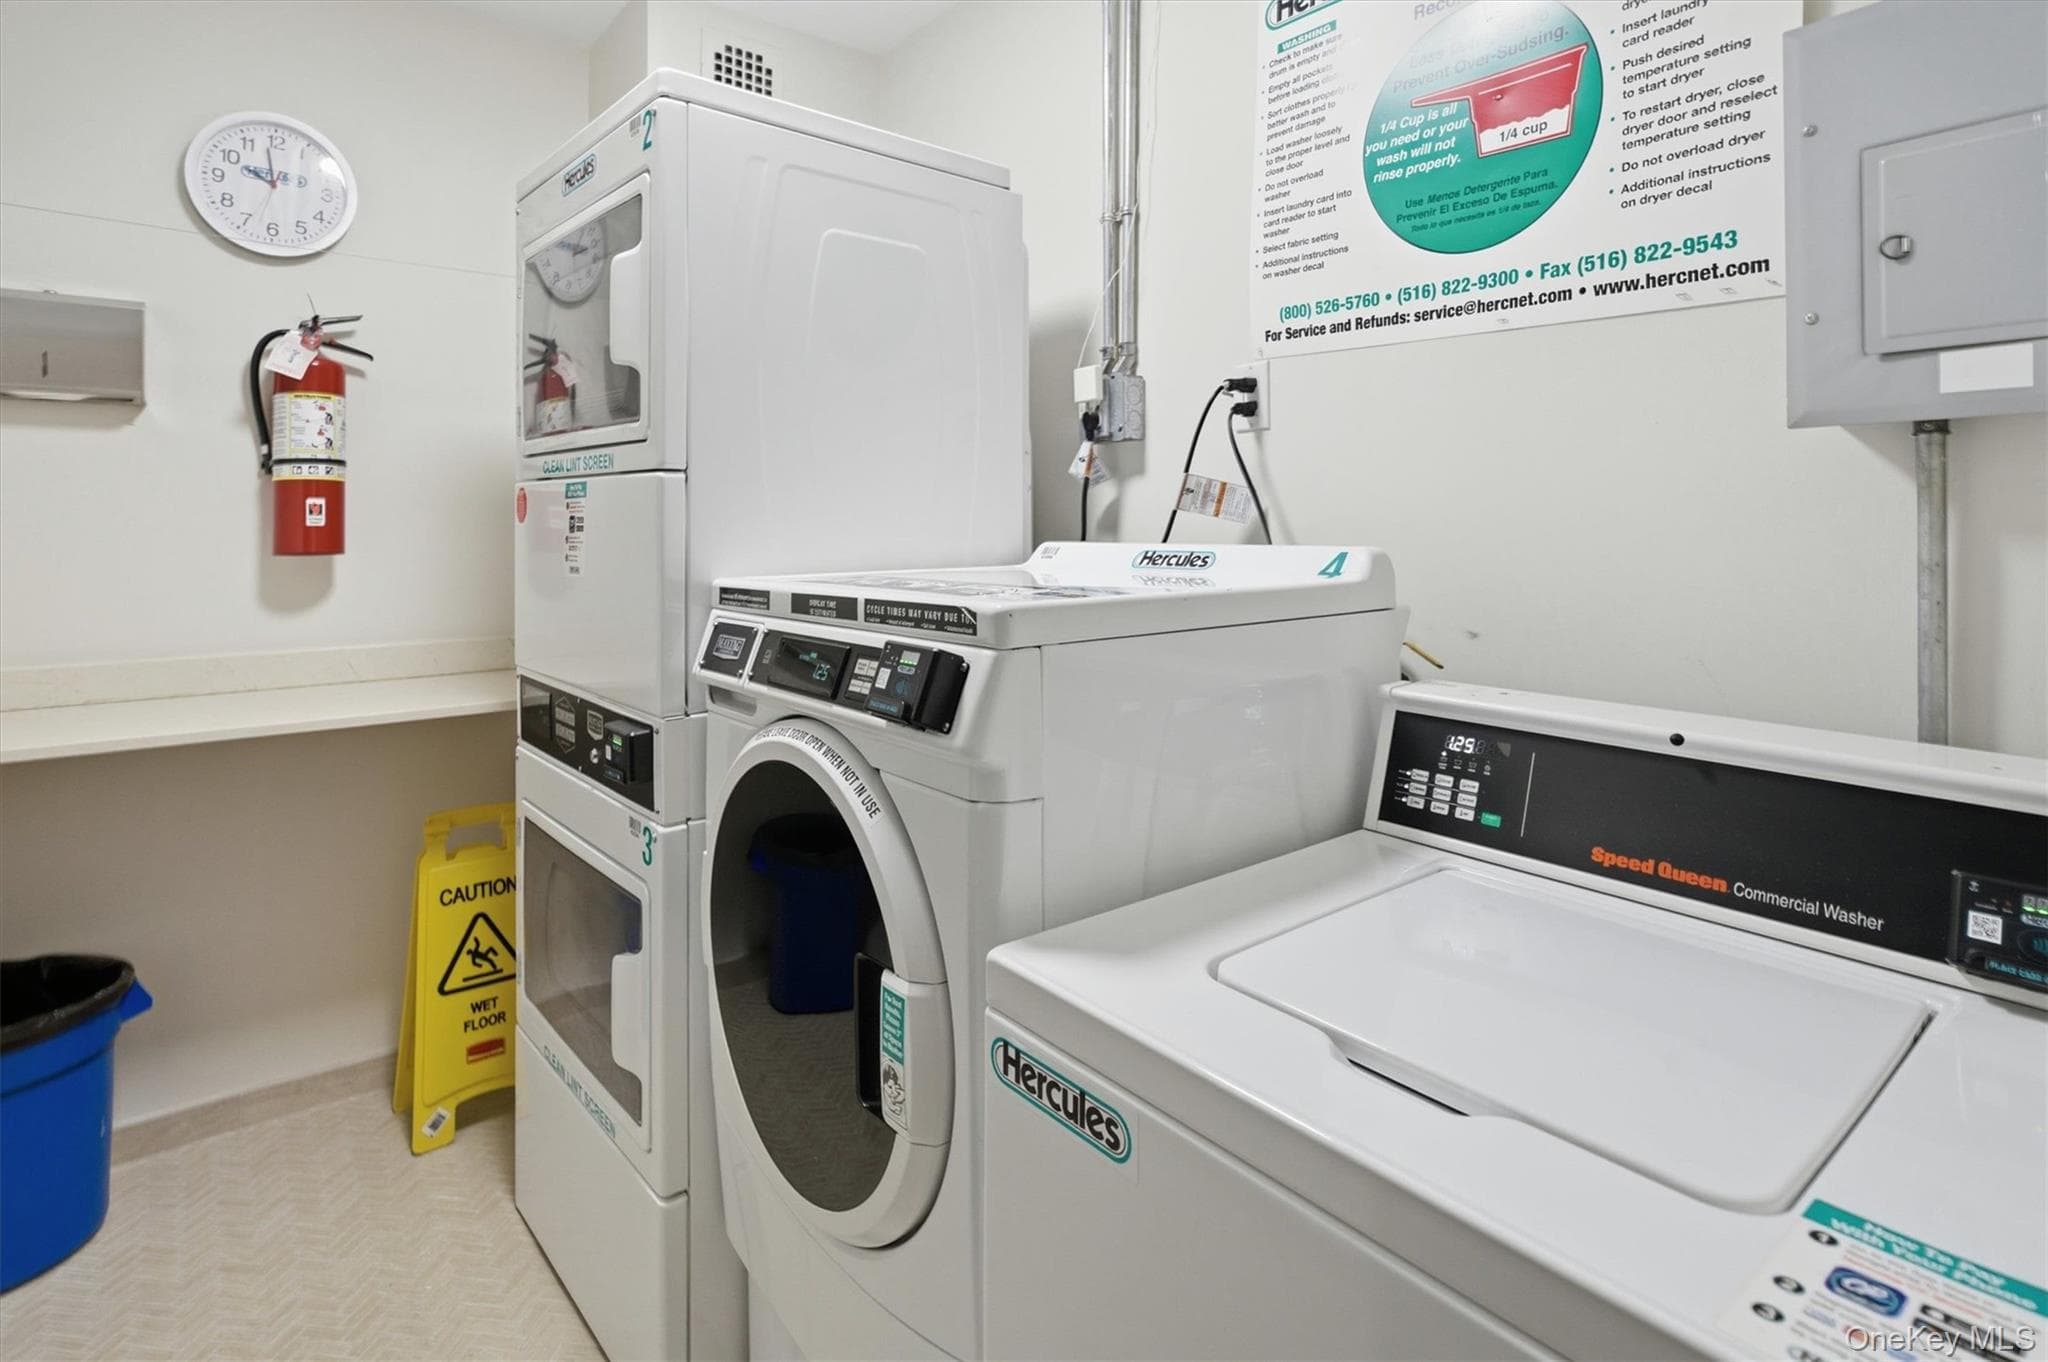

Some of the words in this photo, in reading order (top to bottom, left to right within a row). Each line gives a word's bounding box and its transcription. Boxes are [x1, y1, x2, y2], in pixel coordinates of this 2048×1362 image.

[1622, 13, 1657, 33] Insert
[1660, 0, 1708, 19] laundry
[1622, 30, 1650, 47] card
[1653, 15, 1695, 37] reader
[1281, 23, 1331, 50] WASHING
[1392, 66, 1450, 93] Prevent
[1454, 24, 1570, 75] Over-Sudsing.
[1622, 53, 1700, 84] temperature
[1704, 37, 1752, 59] setting
[1623, 53, 1653, 70] Push
[1656, 34, 1705, 59] desired
[1622, 88, 1634, 99] to
[1638, 78, 1667, 95] start
[1670, 67, 1705, 85] dryer
[1622, 110, 1636, 121] To
[1640, 96, 1682, 116] restart
[1685, 86, 1722, 103] dryer,
[1726, 73, 1765, 92] close
[1267, 108, 1283, 119] Sort
[1283, 99, 1311, 113] clothes
[1267, 118, 1289, 130] better
[1290, 111, 1310, 122] wash
[1311, 104, 1326, 114] and
[1328, 101, 1336, 109] to
[1380, 119, 1396, 134] 1/4
[1399, 112, 1425, 130] Cup
[1429, 107, 1441, 120] is
[1442, 103, 1458, 118] all
[1622, 119, 1654, 136] dryer
[1657, 111, 1688, 127] door
[1691, 101, 1716, 117] and
[1720, 84, 1778, 110] reselect
[267, 135, 286, 151] 12
[642, 110, 653, 151] 2
[1266, 126, 1293, 141] prevent
[1295, 116, 1326, 131] damage
[1266, 144, 1285, 156] Load
[1285, 136, 1313, 149] washer
[1314, 126, 1343, 140] loosely
[1365, 139, 1388, 157] you
[1390, 132, 1419, 148] need
[1422, 129, 1438, 142] or
[1440, 117, 1469, 136] your
[1499, 128, 1518, 142] 1/4
[1522, 121, 1548, 137] cup
[1622, 122, 1700, 150] temperature
[1703, 110, 1751, 130] setting
[220, 148, 241, 165] 10
[240, 136, 255, 152] 11
[1265, 159, 1273, 167] to
[1274, 155, 1286, 163] the
[1287, 146, 1313, 160] proper
[1314, 139, 1333, 150] level
[1334, 134, 1350, 145] and
[1376, 150, 1408, 166] wash
[1411, 143, 1431, 158] will
[1434, 137, 1456, 152] not
[1622, 161, 1639, 172] Do
[1642, 154, 1663, 167] not
[1666, 138, 1724, 162] overload
[1728, 129, 1766, 147] dryer
[211, 168, 225, 183] 9
[563, 158, 594, 191] Hercules
[1264, 183, 1275, 192] Do
[1276, 179, 1288, 188] not
[1290, 169, 1324, 184] overload
[1265, 166, 1285, 177] close
[1286, 160, 1303, 170] door
[1373, 168, 1403, 183] rinse
[1405, 153, 1461, 179] properly.
[1620, 170, 1684, 194] Additional
[1688, 153, 1771, 180] instructions
[220, 192, 234, 208] 8
[1264, 190, 1291, 202] washer
[1396, 208, 1437, 224] Prevenir
[1440, 204, 1450, 214] El
[1452, 197, 1490, 212] Exceso
[1493, 192, 1507, 203] De
[1510, 181, 1558, 200] Espuma.
[1405, 197, 1424, 209] Use
[1427, 189, 1461, 204] Menos
[1463, 175, 1520, 197] Detergente
[1523, 168, 1549, 181] Para
[1621, 198, 1636, 209] on
[1639, 190, 1673, 205] dryer
[1676, 180, 1713, 197] decal
[313, 210, 325, 224] 4
[1263, 217, 1280, 228] card
[1281, 211, 1306, 224] reader
[1307, 210, 1316, 218] to
[1317, 204, 1336, 215] start
[1264, 206, 1285, 217] Insert
[1286, 199, 1315, 211] laundry
[1316, 193, 1334, 204] card
[1336, 190, 1352, 199] into
[240, 211, 253, 226] 7
[266, 222, 279, 237] 6
[295, 219, 307, 235] 5
[1263, 227, 1290, 239] washer
[1262, 242, 1286, 254] Select
[1287, 238, 1310, 250] fabric
[1311, 232, 1339, 244] setting
[1262, 253, 1300, 269] Additional
[1301, 245, 1349, 260] instructions
[1262, 272, 1272, 280] on
[1273, 266, 1301, 278] washer
[1302, 261, 1324, 272] decal
[1279, 302, 1311, 324] (800)
[1315, 292, 1380, 315] 526-5760
[1397, 282, 1437, 305] (516)
[1441, 268, 1520, 297] 822-9300
[1539, 262, 1572, 280] Fax
[1577, 249, 1628, 277] (516)
[1634, 229, 1738, 264] 822-9543
[1265, 328, 1282, 342] For
[1285, 324, 1327, 341] Service
[1329, 318, 1352, 334] and
[1355, 312, 1411, 331] Refunds:
[1413, 287, 1572, 323] service@hercnet.com
[1592, 258, 1771, 296] www.hercnet.com
[542, 457, 566, 474] CLEAN
[566, 455, 582, 473] LINT
[582, 453, 615, 472] SCREEN
[1139, 550, 1210, 569] Hercules
[1318, 552, 1349, 579] 4
[866, 604, 885, 616] CYCLE
[887, 606, 906, 618] TIMES
[908, 608, 922, 619] MAY
[924, 610, 941, 621] VARY
[944, 612, 958, 623] DUE
[805, 734, 826, 752] OPEN
[821, 745, 846, 770] WHEN
[840, 764, 860, 786] NOT
[853, 782, 868, 798] IN
[861, 794, 881, 819] USE
[642, 826, 652, 866] 3
[440, 875, 517, 906] CAUTION
[1590, 846, 1654, 875] Speed
[1658, 862, 1728, 893] Queen
[1733, 882, 1820, 916] Commercial
[1823, 902, 1884, 931] Washer
[470, 996, 499, 1014] WET
[463, 1011, 507, 1033] FLOOR
[1003, 1041, 1121, 1152] Hercules
[1830, 1217, 1885, 1249] With
[1892, 1243, 1949, 1274] Your
[1952, 1270, 2039, 1311] Phone
[1863, 1221, 1919, 1252] How
[1925, 1246, 1955, 1266] To
[1959, 1260, 2006, 1287] Pay
